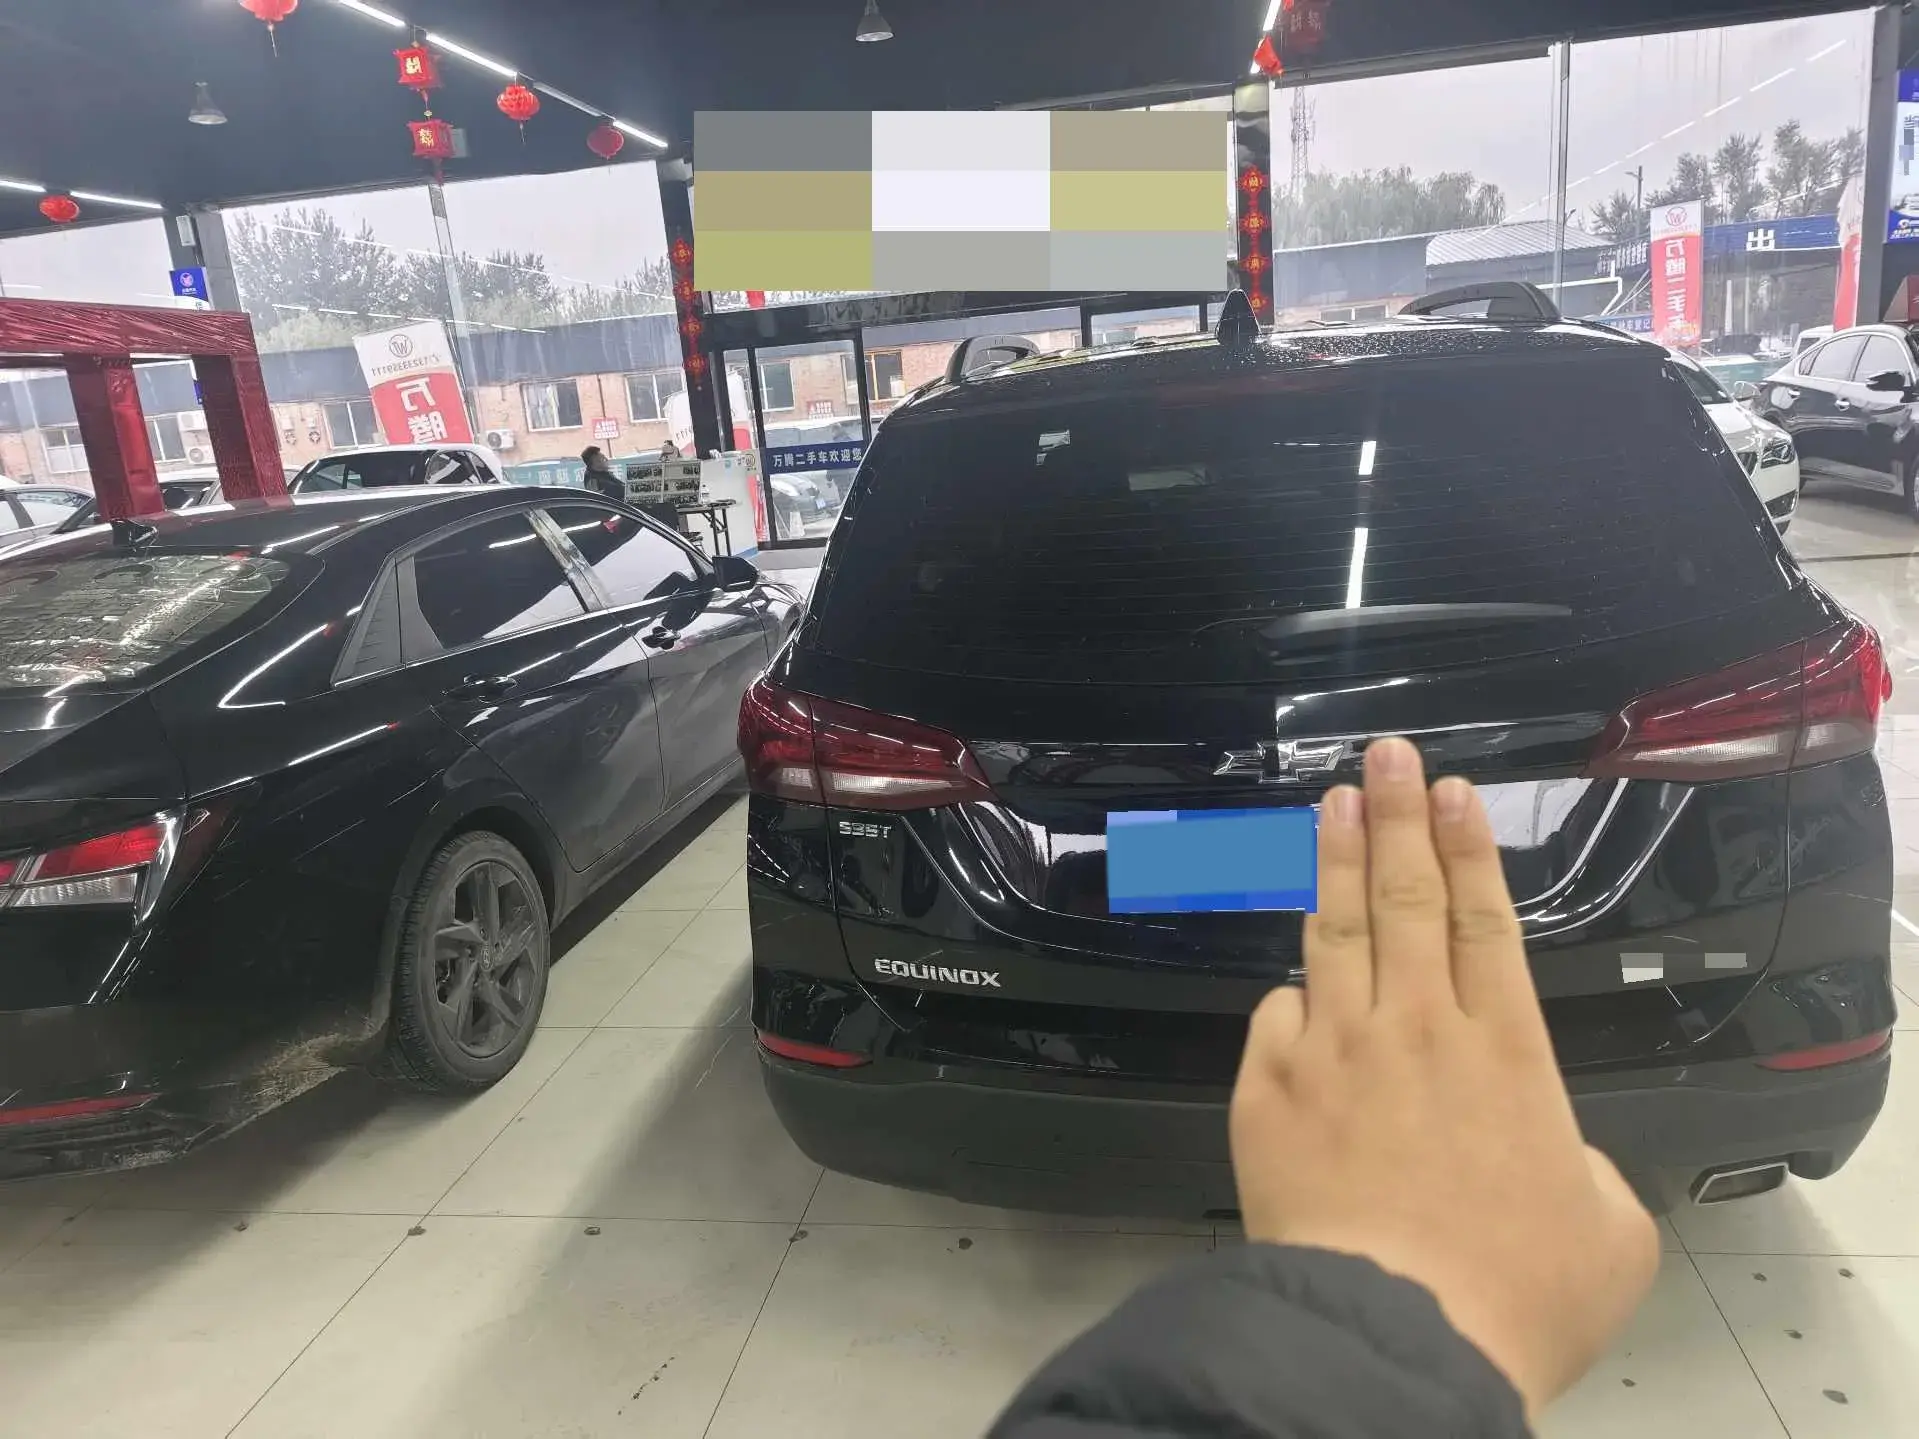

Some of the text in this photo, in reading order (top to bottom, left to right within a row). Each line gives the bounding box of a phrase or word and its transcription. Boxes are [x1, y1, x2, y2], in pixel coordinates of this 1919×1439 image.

[772, 448, 862, 468] 万腾二手车欢迎您
[874, 958, 1001, 987] EQUINOX
